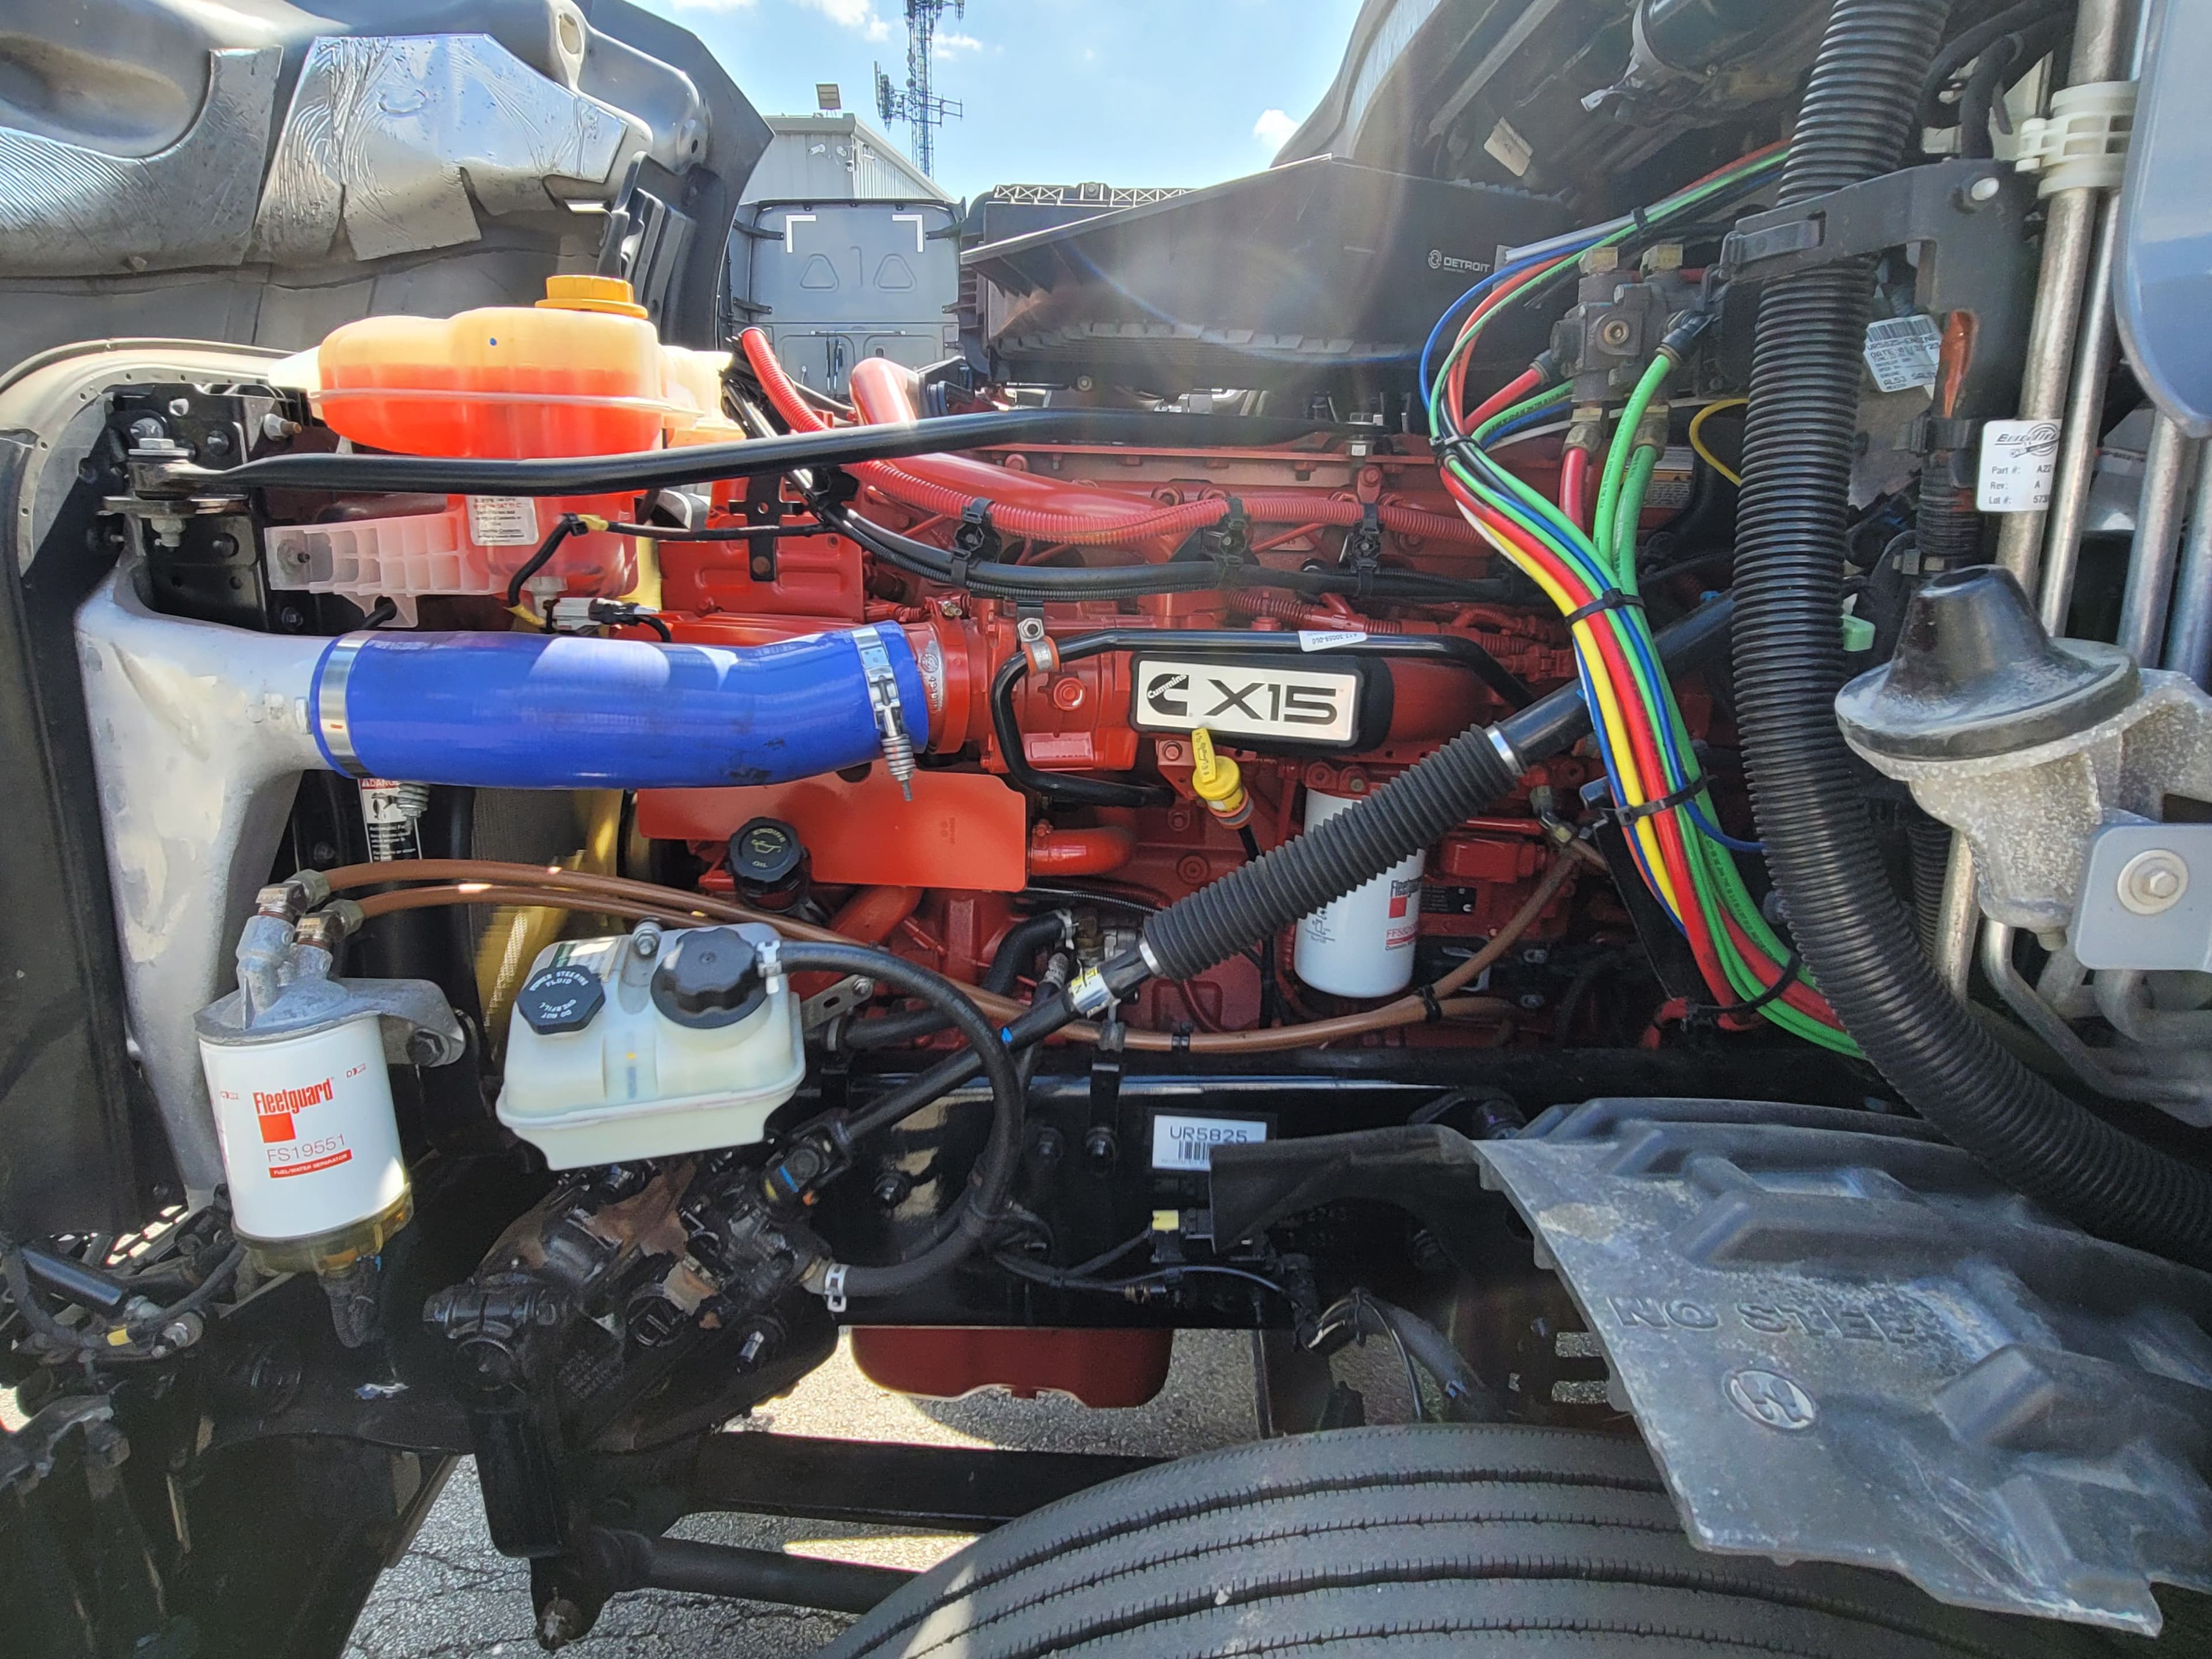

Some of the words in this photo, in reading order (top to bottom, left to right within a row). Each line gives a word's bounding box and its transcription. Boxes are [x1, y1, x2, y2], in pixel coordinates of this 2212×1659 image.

[1444, 257, 1491, 272] DETROIT
[1991, 465, 2009, 475] Part
[1990, 481, 2009, 490] Rev:
[2034, 480, 2041, 489] A
[1988, 496, 2001, 505] Lot
[1147, 673, 1188, 699] Cummins
[1203, 679, 1338, 725] X15
[370, 779, 401, 787] DANGE
[751, 827, 787, 843] ENGINE
[752, 860, 768, 868] OIL
[528, 973, 553, 991] POWER
[555, 970, 590, 987] STEERING
[544, 978, 573, 988] FLUID
[252, 1077, 334, 1114] Fleetguard
[1169, 1125, 1248, 1143] UR5825
[266, 1133, 346, 1163] FS19551
[273, 1164, 312, 1176] FUEL/WATER
[312, 1153, 348, 1169] SEPARATOR
[1607, 1296, 1722, 1331] NO
[1736, 1301, 1917, 1344] STEP
